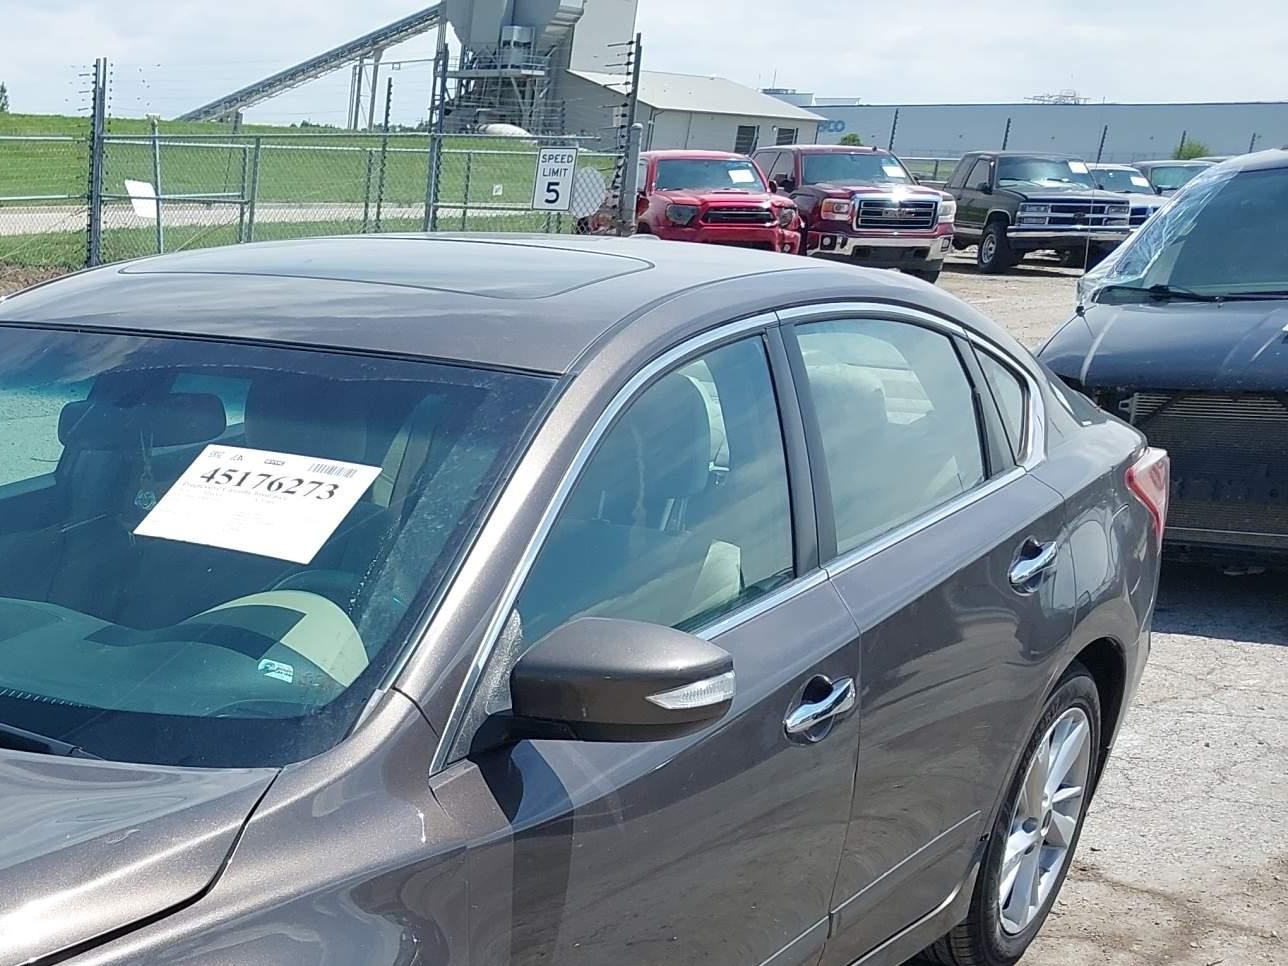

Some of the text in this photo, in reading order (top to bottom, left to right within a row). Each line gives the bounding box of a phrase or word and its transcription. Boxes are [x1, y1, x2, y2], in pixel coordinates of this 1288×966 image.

[541, 154, 574, 164] SPEED
[542, 168, 569, 178] LIMIT
[544, 181, 561, 204] 5
[200, 467, 340, 501] 45176273
